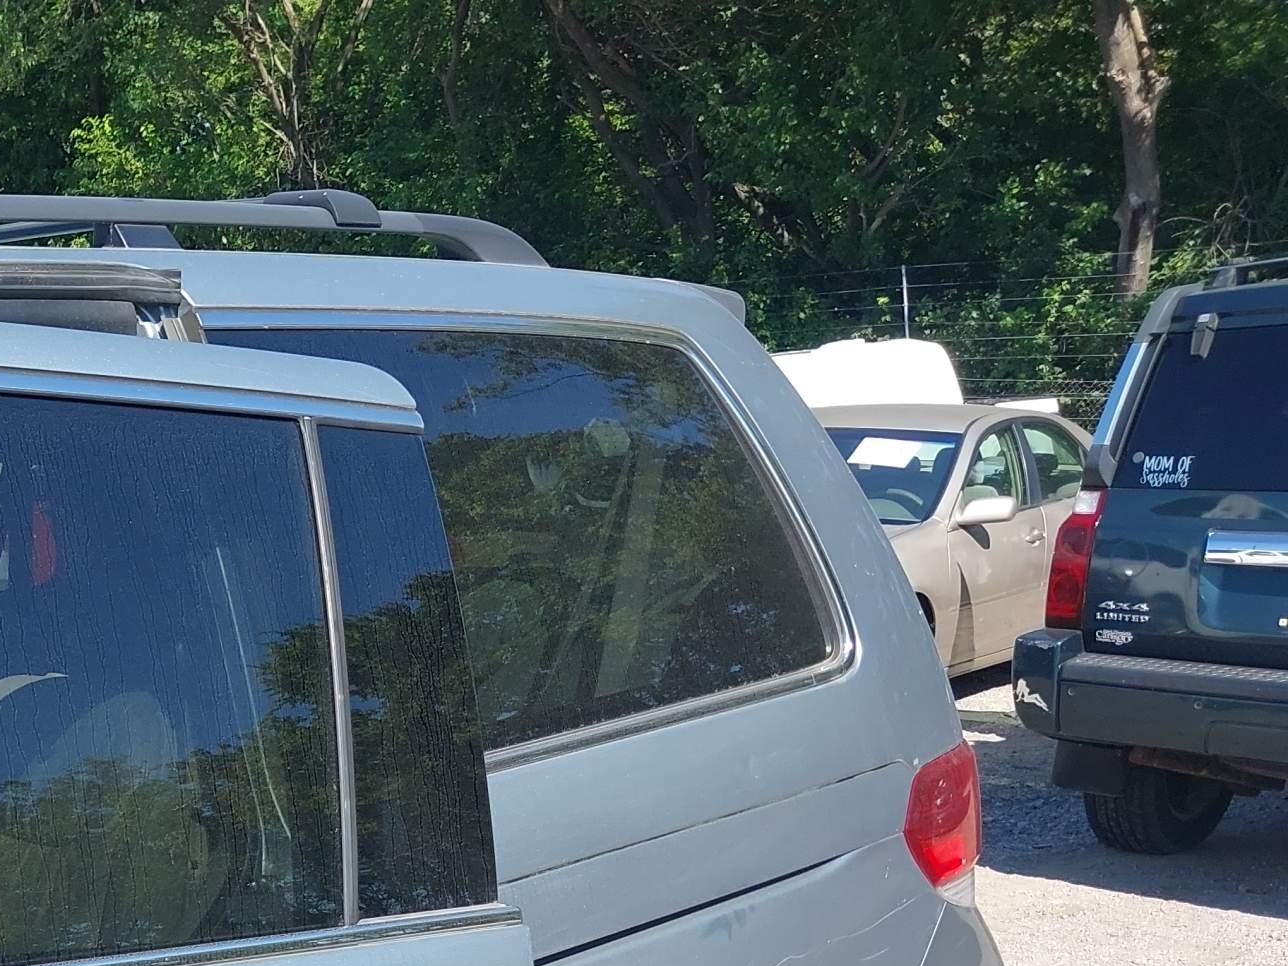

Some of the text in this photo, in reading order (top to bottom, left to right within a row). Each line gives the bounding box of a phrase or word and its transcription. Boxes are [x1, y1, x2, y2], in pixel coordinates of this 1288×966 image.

[1143, 455, 1196, 472] MOM OF
[1140, 468, 1192, 488] Sassholes
[1095, 612, 1151, 622] LIMITED
